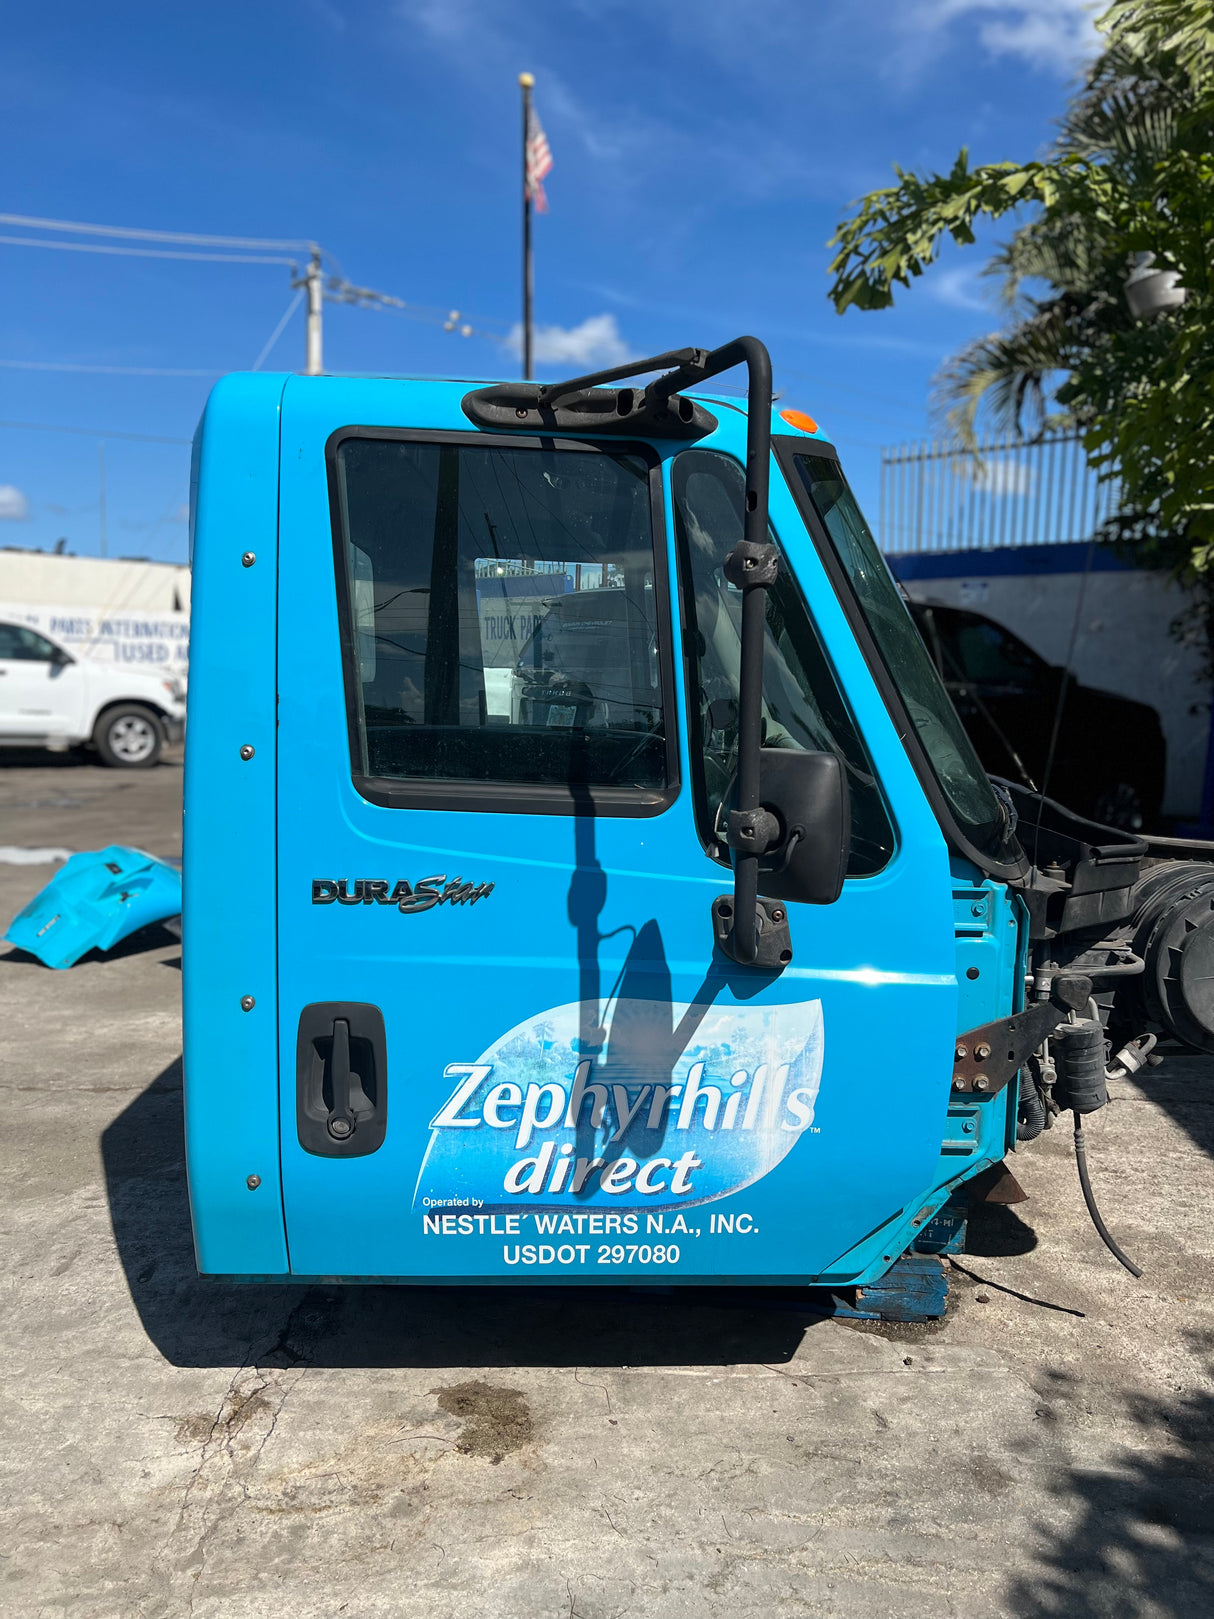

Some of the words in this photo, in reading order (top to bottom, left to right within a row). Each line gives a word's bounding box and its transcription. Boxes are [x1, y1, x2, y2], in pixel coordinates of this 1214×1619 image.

[484, 615, 517, 640] TRUCK
[429, 1059, 819, 1150] Zephyrhills
[503, 1141, 704, 1195] direct
[422, 1197, 469, 1207] Operated
[471, 1197, 484, 1207] by
[534, 1213, 639, 1235] WATERS
[646, 1213, 701, 1238] N.A.,
[709, 1212, 760, 1234] INC.
[503, 1244, 591, 1265] USDOT
[597, 1244, 681, 1265] 297080
